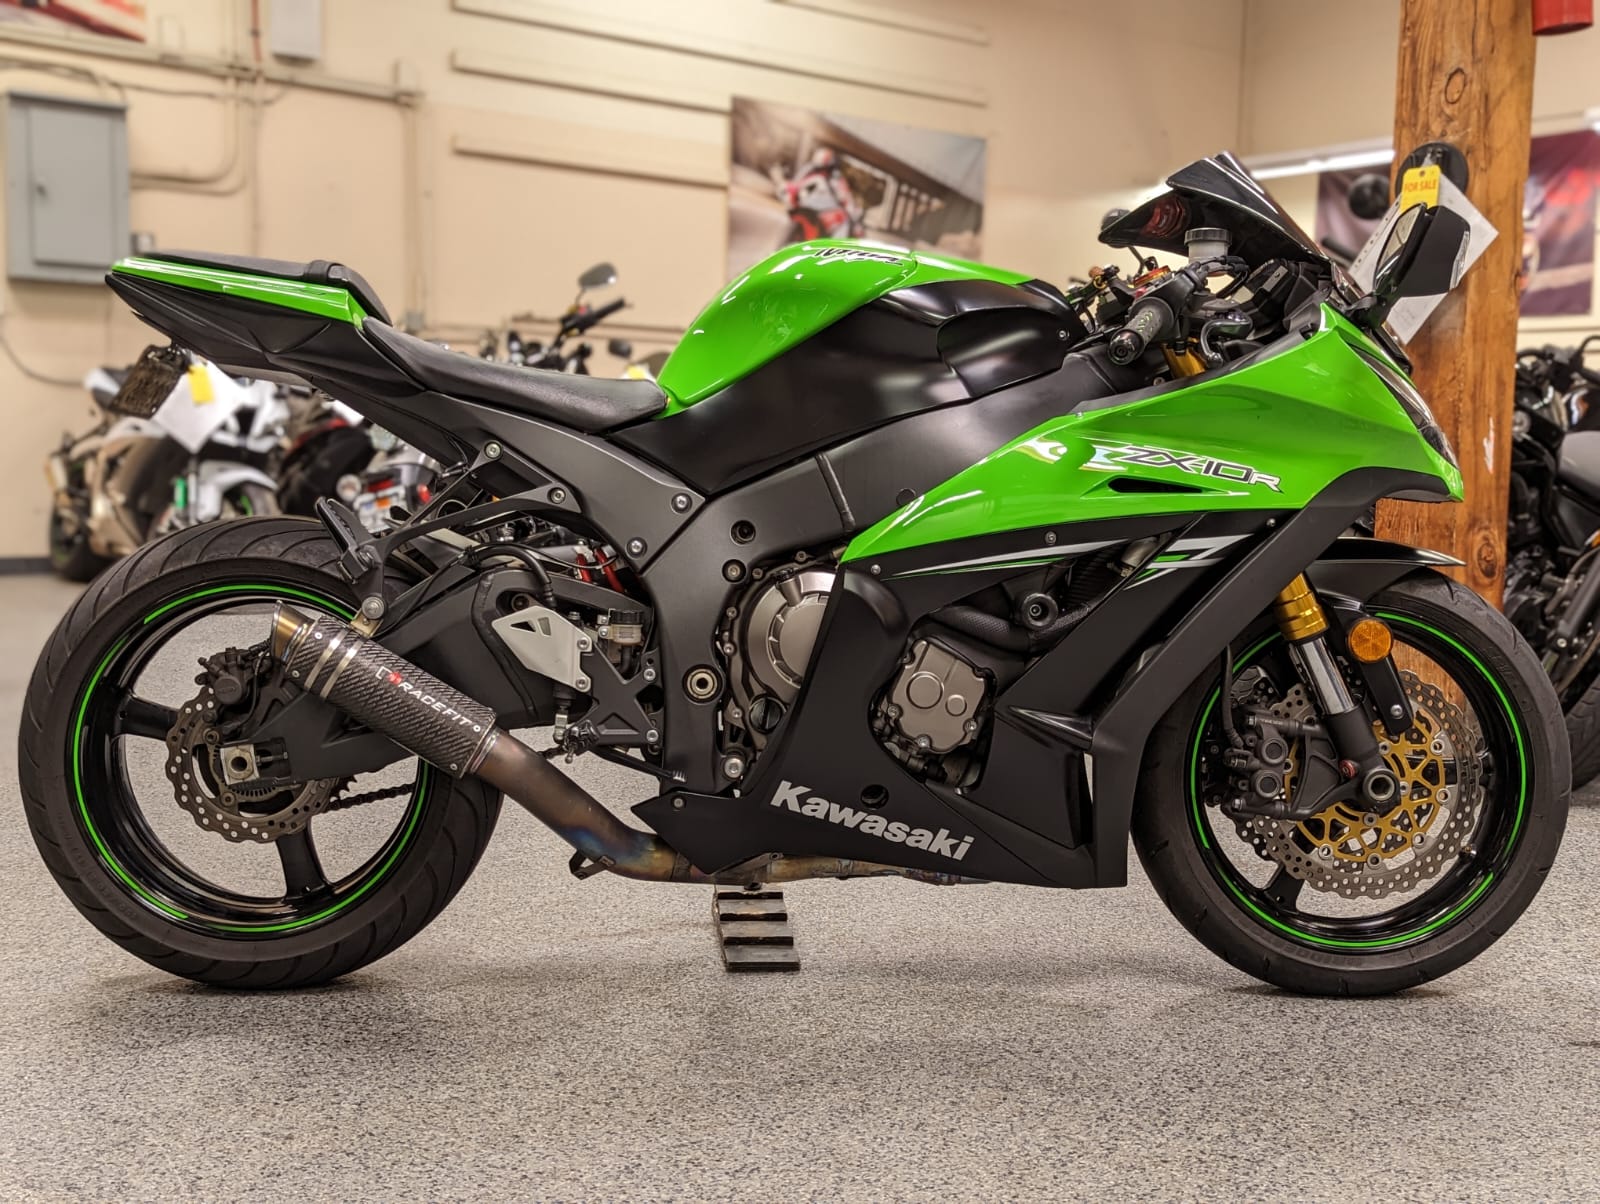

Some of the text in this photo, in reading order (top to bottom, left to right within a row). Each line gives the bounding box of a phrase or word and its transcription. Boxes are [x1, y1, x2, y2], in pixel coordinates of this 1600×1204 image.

[1404, 179, 1437, 192] FOR SALE
[398, 681, 473, 725] RACEFIT
[769, 779, 975, 861] Kawasaki
